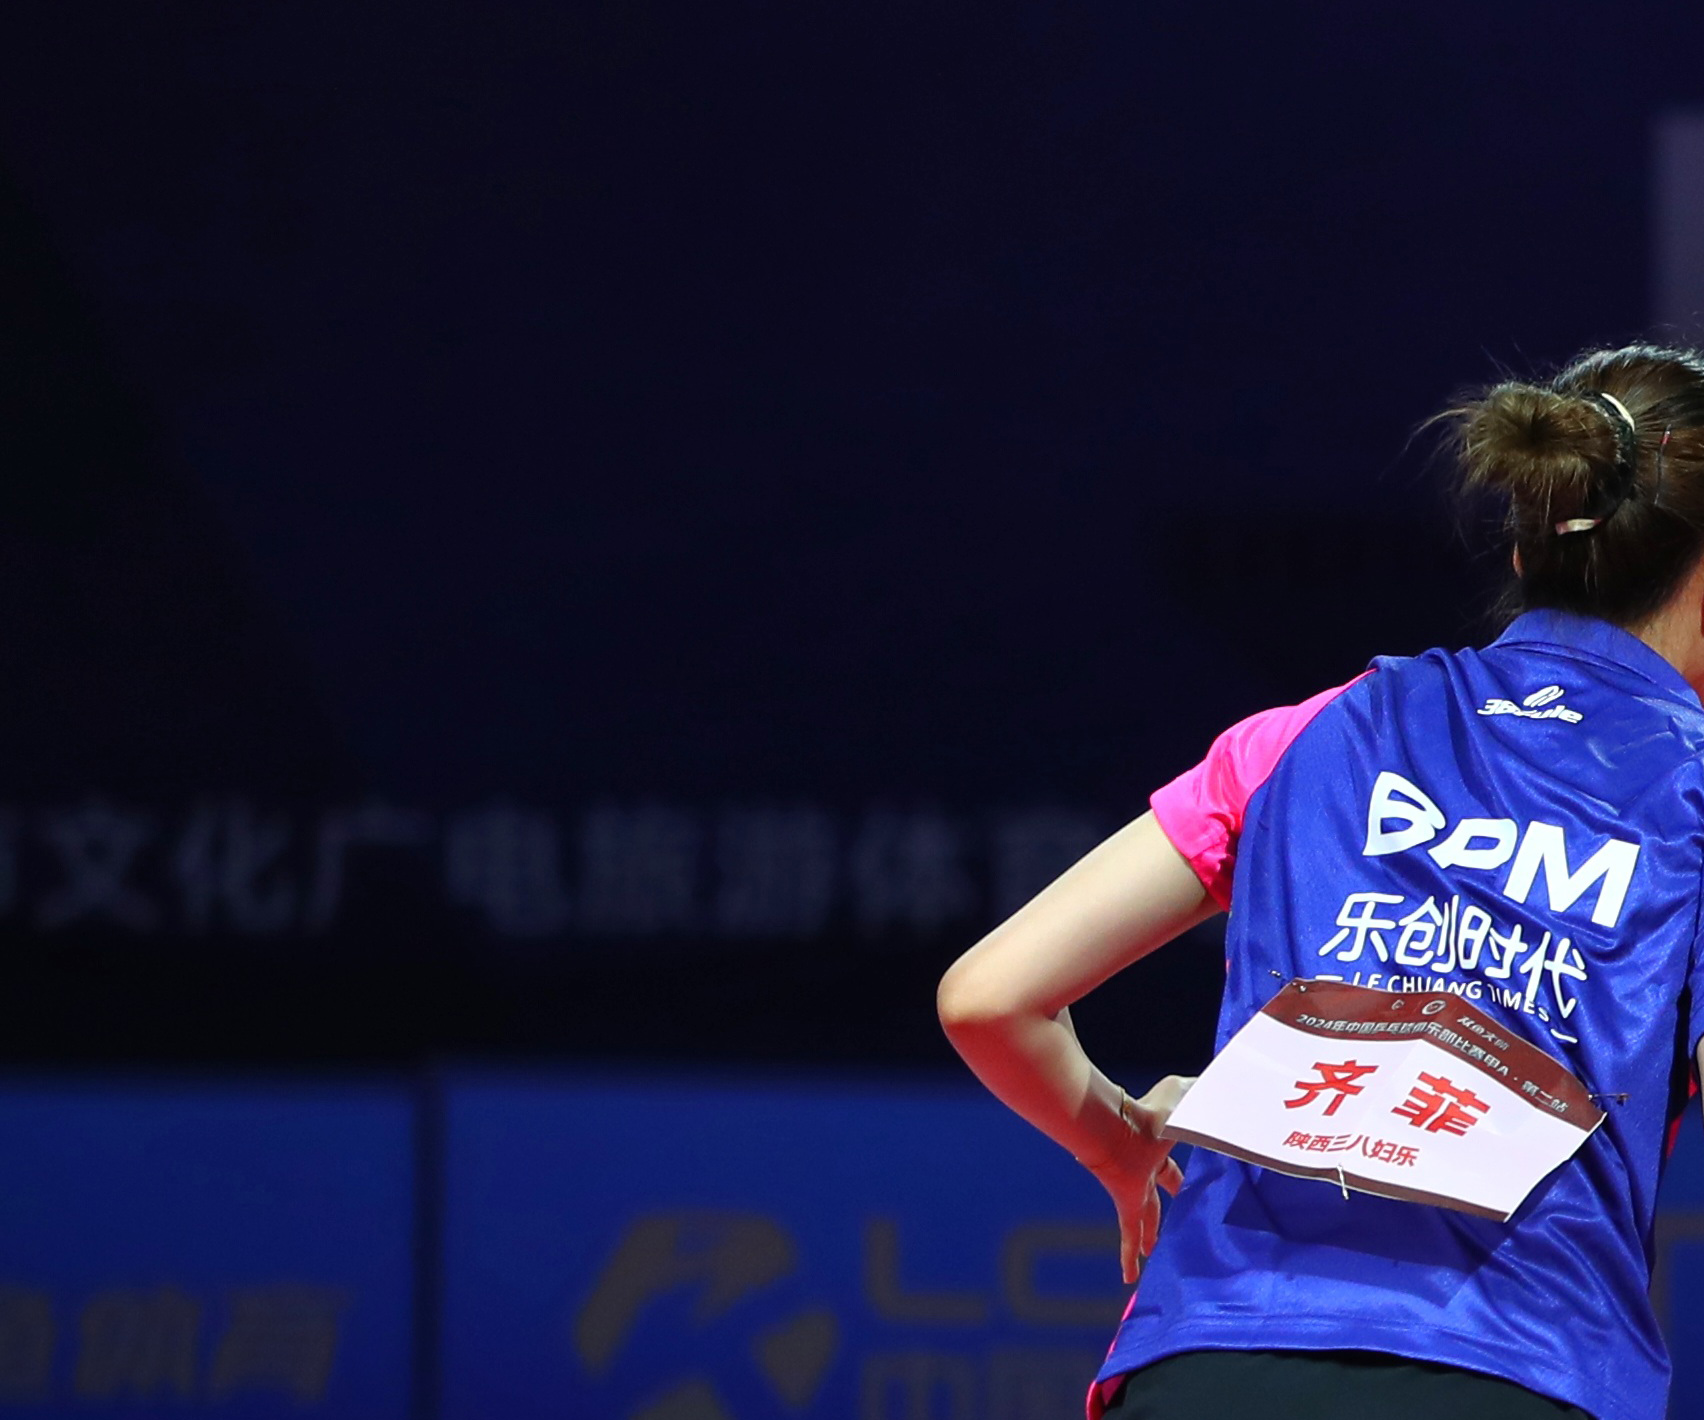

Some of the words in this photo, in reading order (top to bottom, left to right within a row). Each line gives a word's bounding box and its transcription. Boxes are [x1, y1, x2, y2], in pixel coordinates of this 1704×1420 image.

[1362, 772, 1640, 928] BPM
[1319, 892, 1587, 1019] 乐创时代
[1387, 974, 1482, 999] CHUANG
[1282, 1130, 1421, 1167] 陕西三八妇乐
